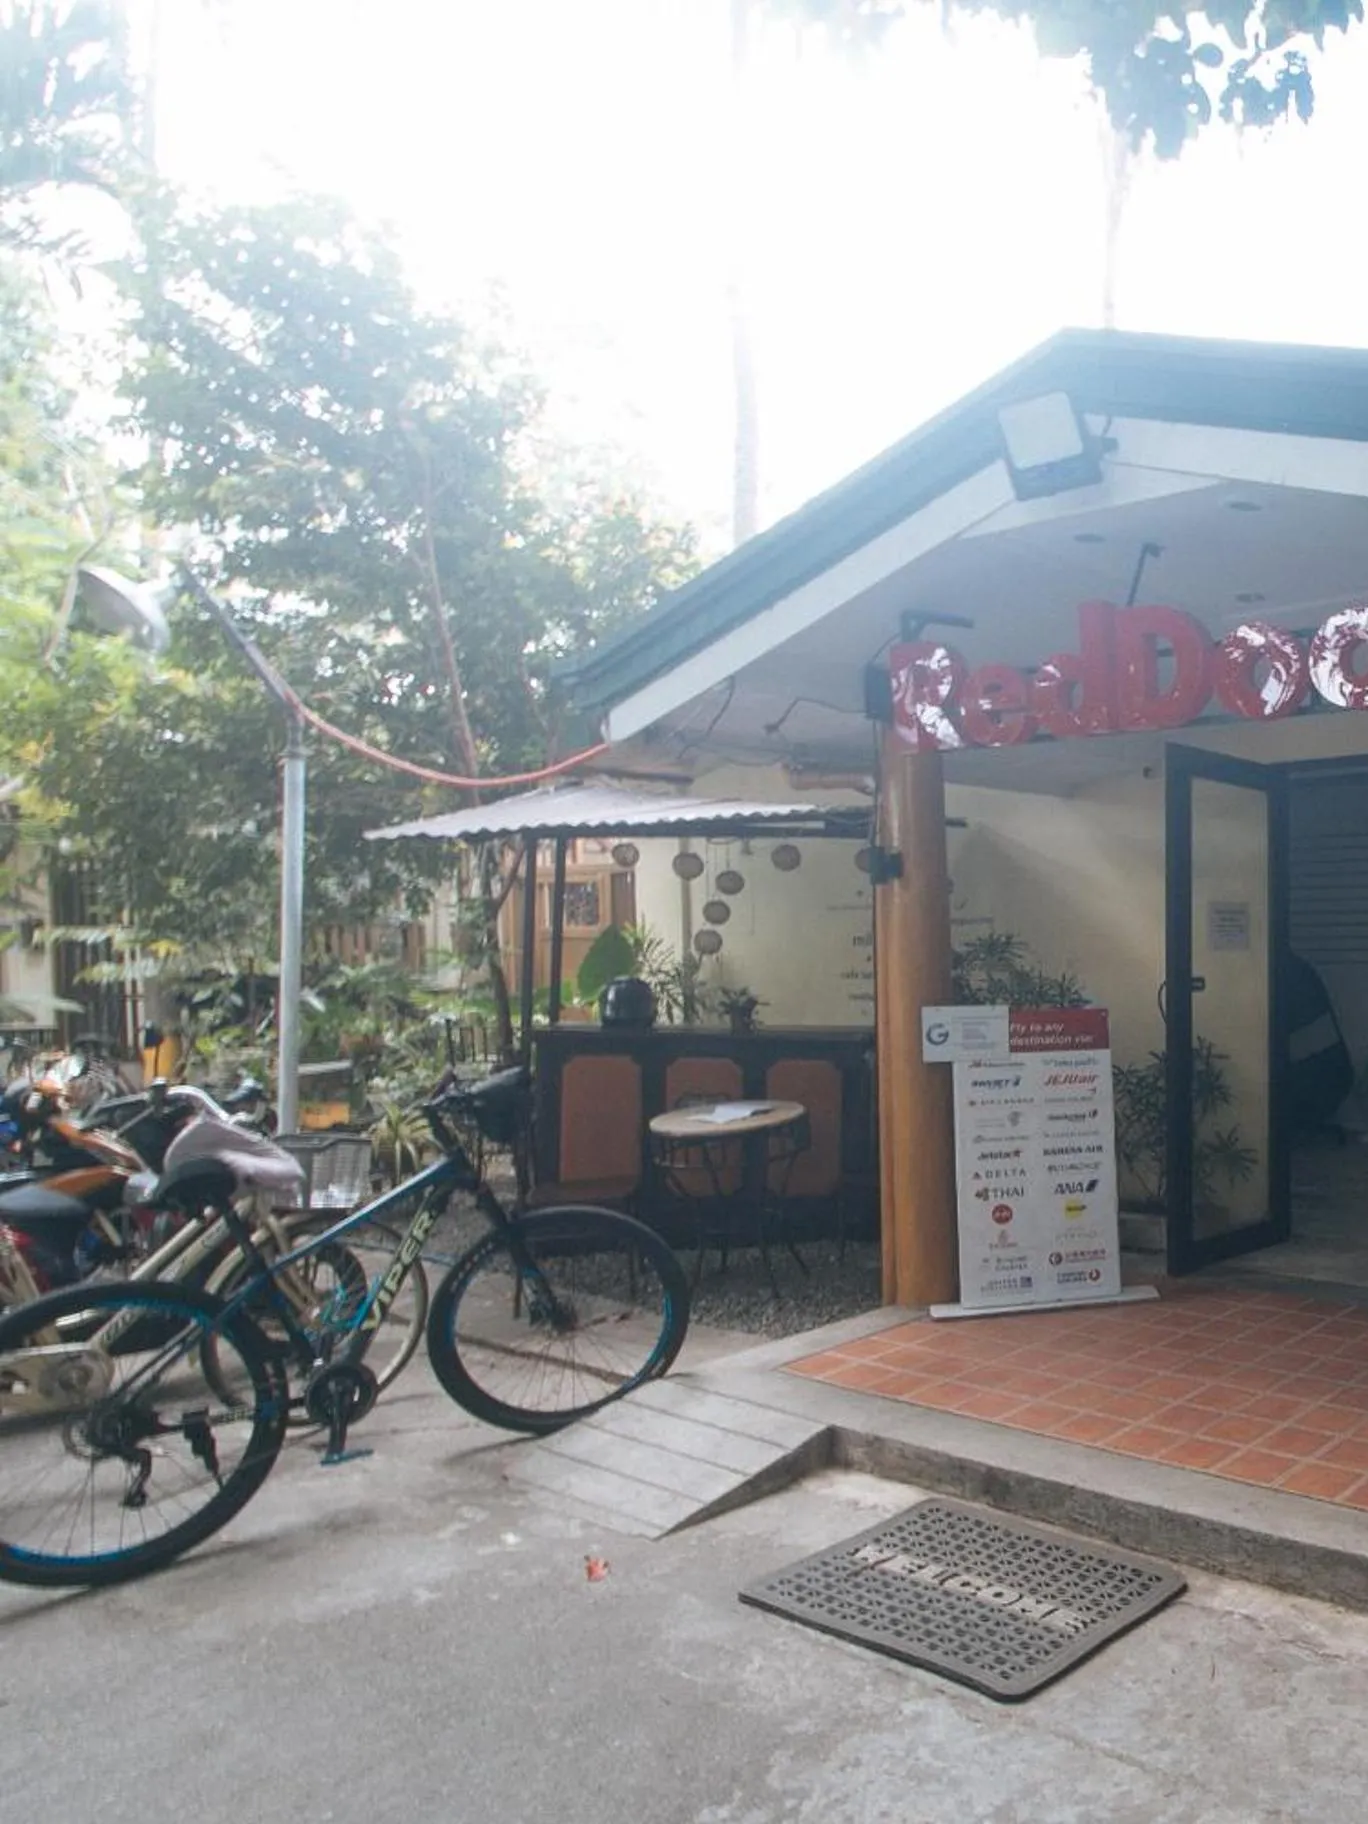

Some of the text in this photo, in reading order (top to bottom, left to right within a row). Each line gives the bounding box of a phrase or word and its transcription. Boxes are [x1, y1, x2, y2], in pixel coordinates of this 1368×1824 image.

[1029, 1022, 1043, 1032] to
[1044, 1022, 1064, 1033] any
[1010, 1033, 1072, 1046] destination
[985, 1167, 1027, 1180] DELTA
[992, 1186, 1025, 1199] THAI
[1054, 1181, 1084, 1195] ANA
[362, 1207, 436, 1330] VIPER
[850, 1543, 1091, 1635] WELCOME
